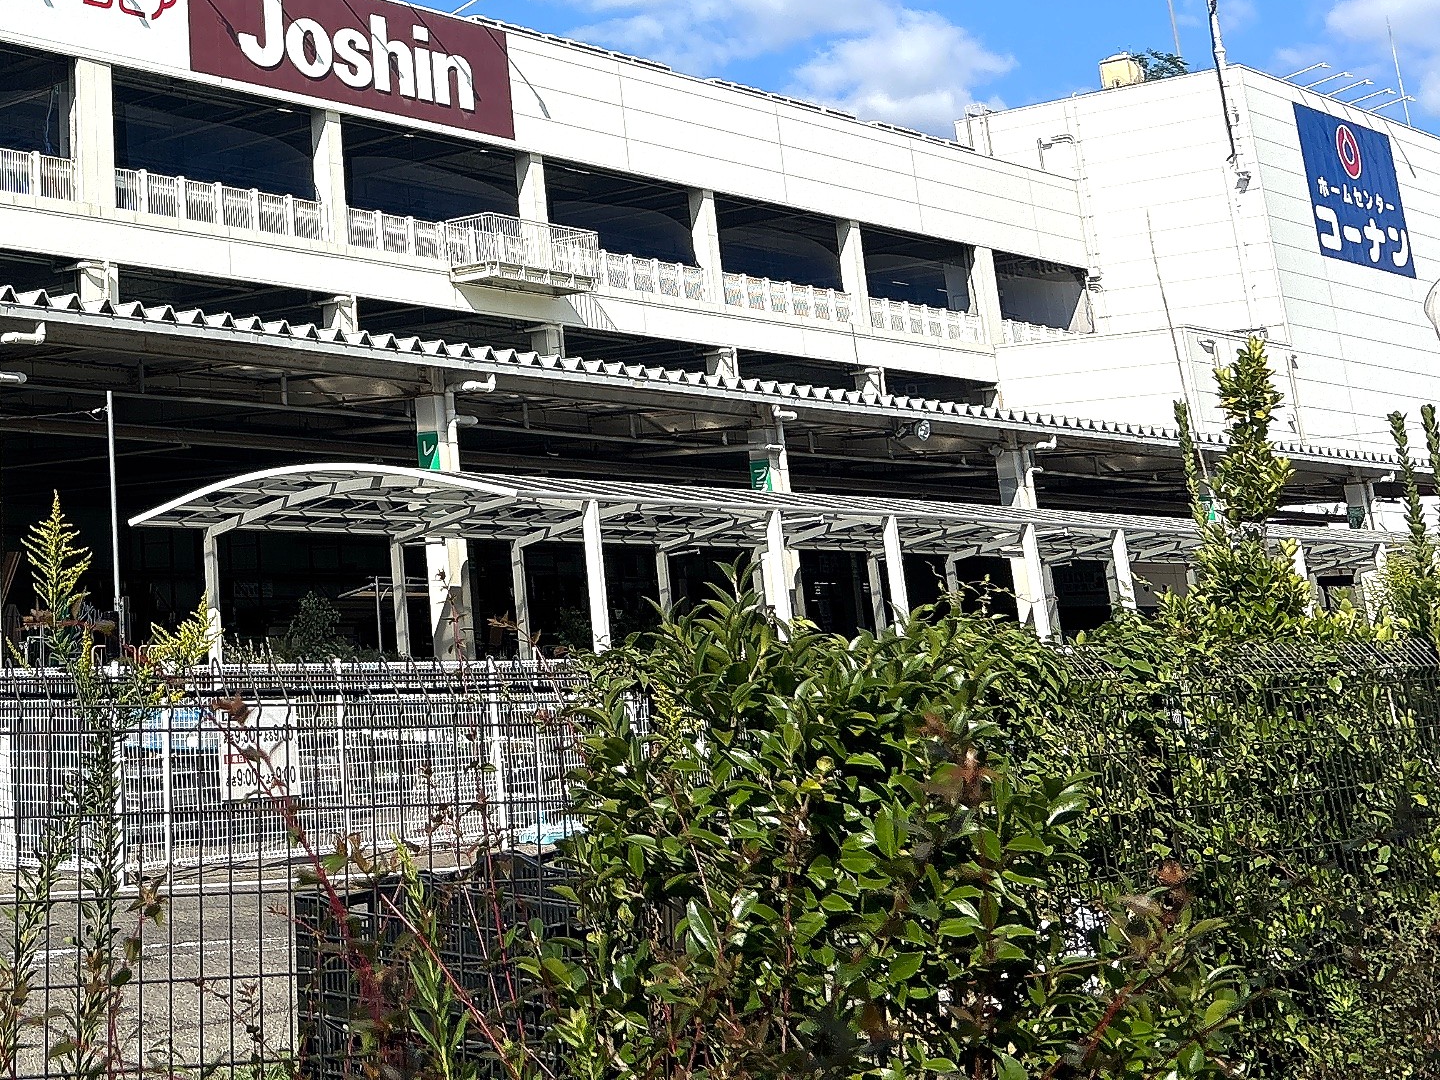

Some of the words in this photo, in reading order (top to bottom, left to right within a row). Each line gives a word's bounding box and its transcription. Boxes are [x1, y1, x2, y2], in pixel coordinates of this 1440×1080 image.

[1317, 176, 1395, 214] ホームセンター
[1315, 204, 1409, 267] コーナン
